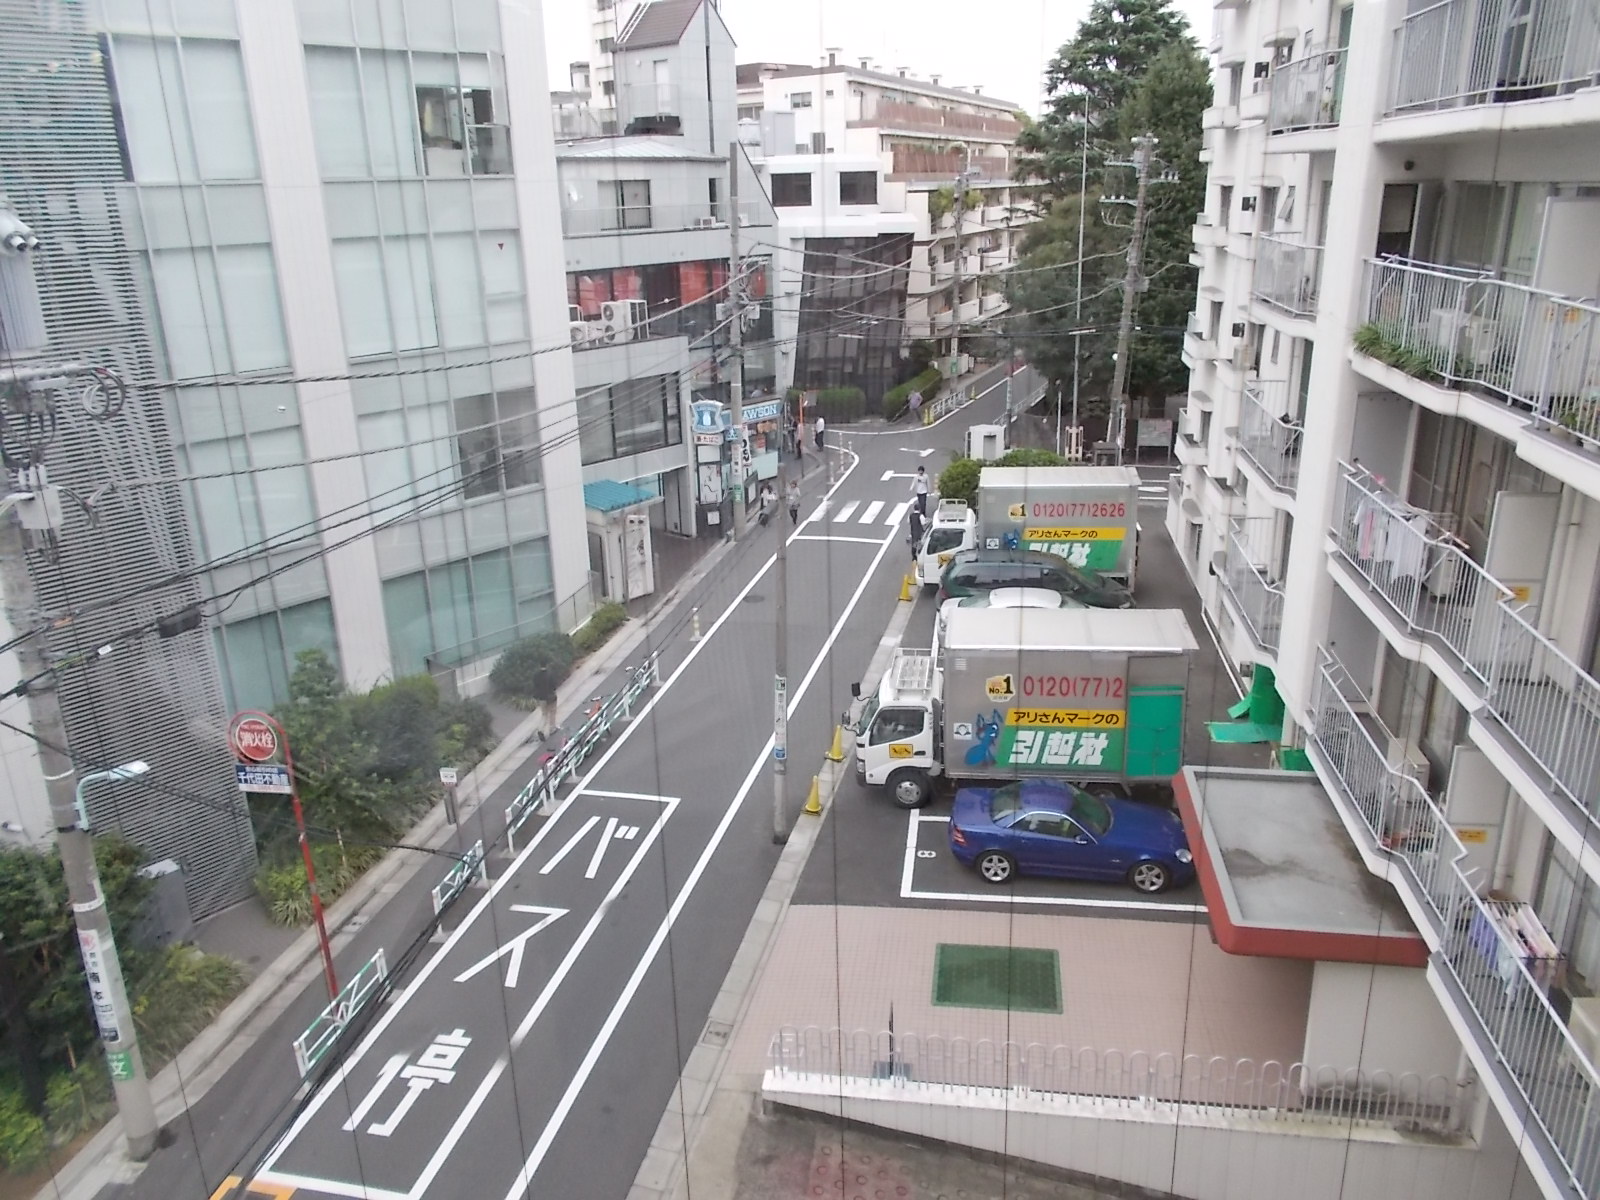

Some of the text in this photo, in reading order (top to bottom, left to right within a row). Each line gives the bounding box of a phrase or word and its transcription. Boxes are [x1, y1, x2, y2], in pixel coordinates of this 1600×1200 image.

[742, 404, 777, 420] AWSON
[1033, 503, 1125, 517] 0120(77)2626
[1028, 530, 1098, 539] アリさんマークの
[989, 675, 1013, 695] No.1
[1013, 711, 1120, 725] アリさんマークの
[1008, 730, 1109, 765] 引越社
